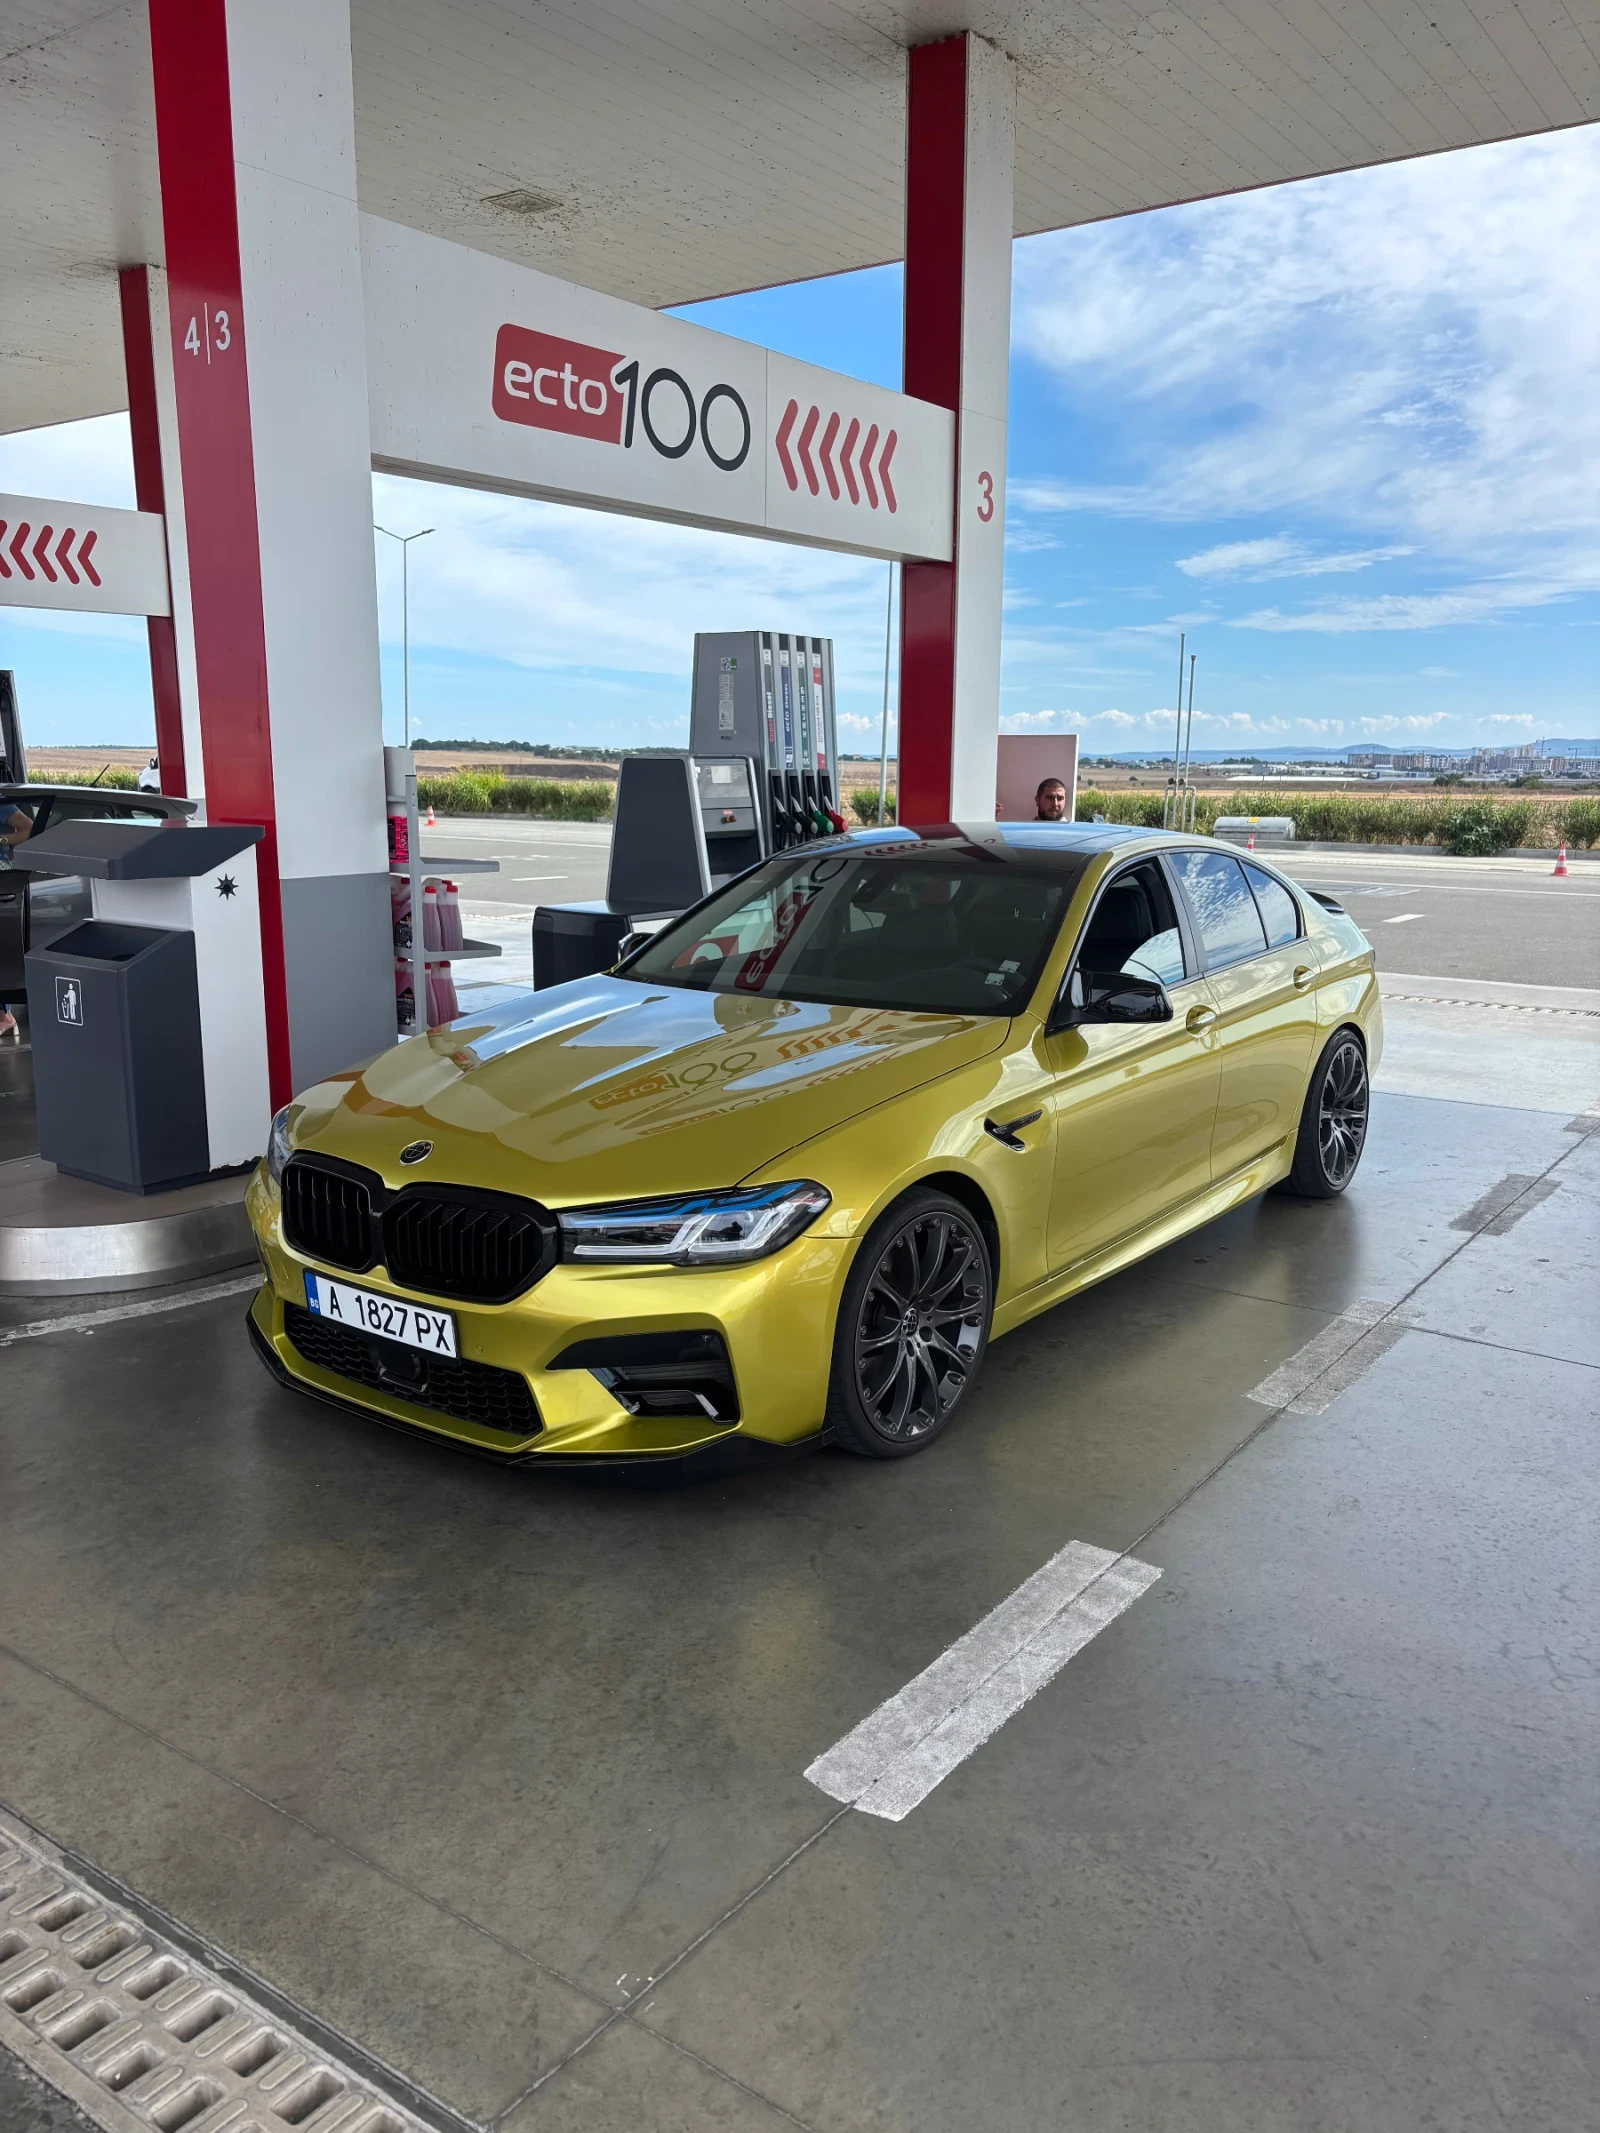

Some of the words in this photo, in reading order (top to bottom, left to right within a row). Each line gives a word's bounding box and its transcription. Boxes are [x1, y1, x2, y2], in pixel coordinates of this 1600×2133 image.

[977, 470, 994, 523] 3
[309, 1297, 319, 1309] BG
[329, 1285, 343, 1319] A
[355, 1294, 408, 1338] 1827
[414, 1311, 451, 1352] PX
